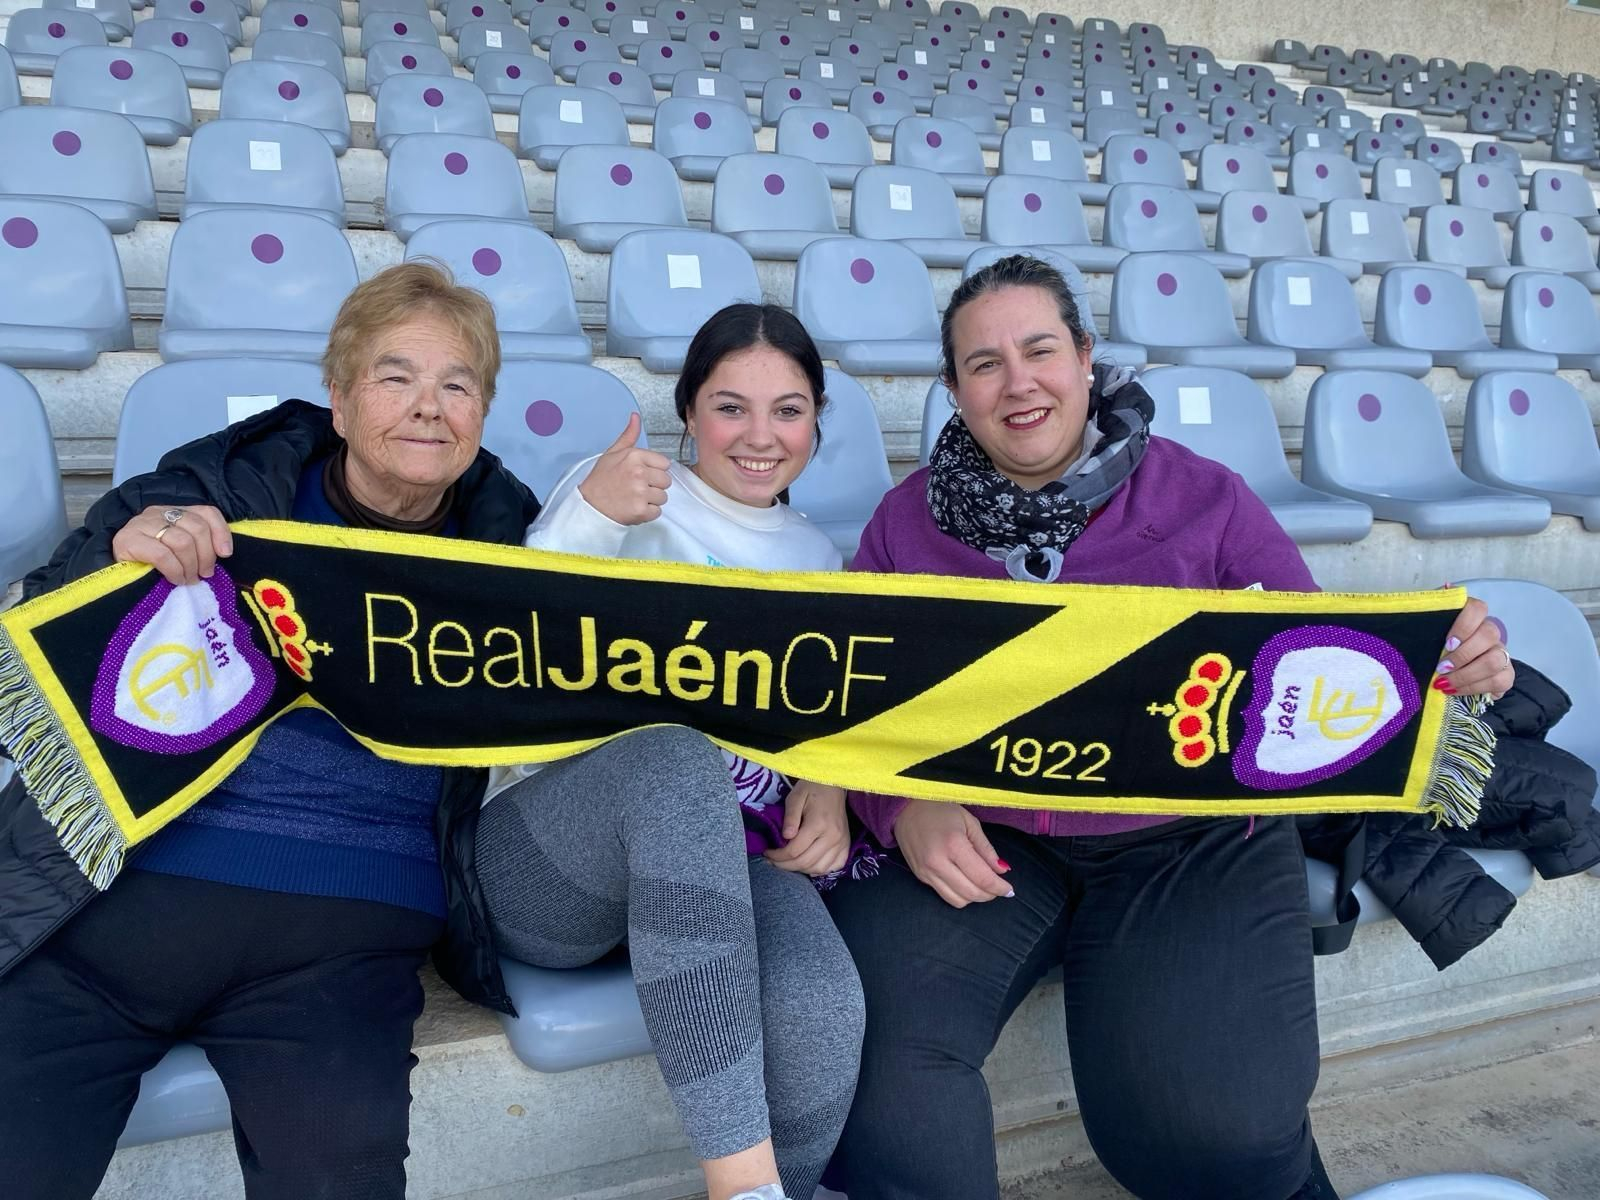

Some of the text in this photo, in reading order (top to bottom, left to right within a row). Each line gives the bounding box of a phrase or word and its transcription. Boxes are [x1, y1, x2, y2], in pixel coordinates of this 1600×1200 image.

[198, 617, 230, 668] jaén
[1271, 685, 1301, 740] jaén
[990, 735, 1112, 782] 1922
